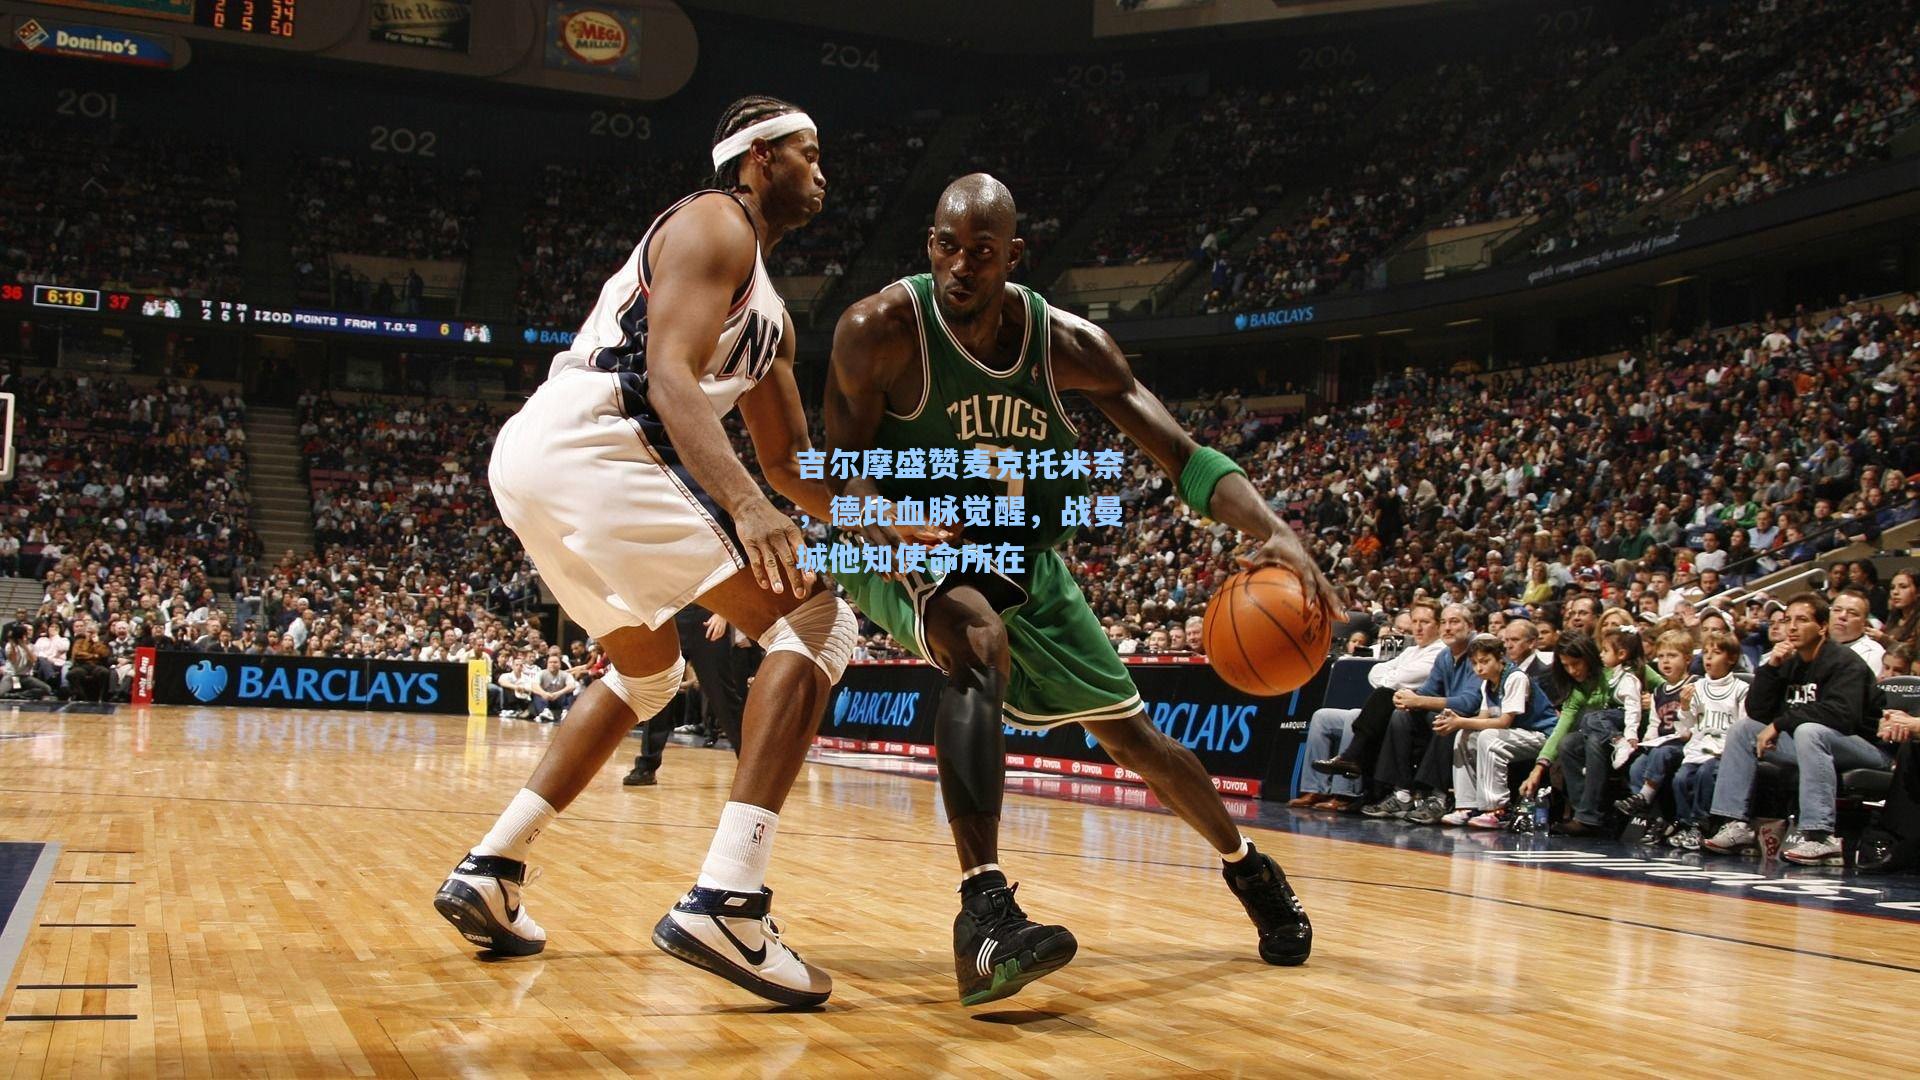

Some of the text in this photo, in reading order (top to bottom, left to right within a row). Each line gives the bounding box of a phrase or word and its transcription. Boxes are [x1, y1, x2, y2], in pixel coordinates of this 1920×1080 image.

[241, 17, 254, 32] 5
[270, 20, 294, 37] 50
[580, 20, 621, 41] MEGA
[56, 30, 138, 55] Domino's
[820, 42, 880, 72] 204
[1298, 46, 1357, 71] 206
[57, 88, 117, 119] 201
[590, 111, 650, 140] 203
[369, 126, 436, 156] 202
[47, 290, 84, 305] 6:19
[109, 295, 130, 309] 37
[202, 309, 212, 320] 2
[238, 312, 246, 323] 1
[254, 310, 293, 323] IZOD
[295, 313, 337, 326] POINTS
[344, 318, 377, 331] FROM
[439, 324, 450, 336] 6
[1250, 306, 1314, 328] BARCLAYS
[238, 666, 439, 705] BARCLAYS
[846, 691, 920, 726] BARCLAYS
[1697, 709, 1734, 731] CLTICS
[1146, 702, 1258, 752] RCLAYS
[1280, 721, 1307, 729] MARQUIS
[1042, 758, 1062, 769] TOYOTA
[1081, 763, 1102, 775] TOYOTA
[1222, 779, 1249, 791] TOYOTA
